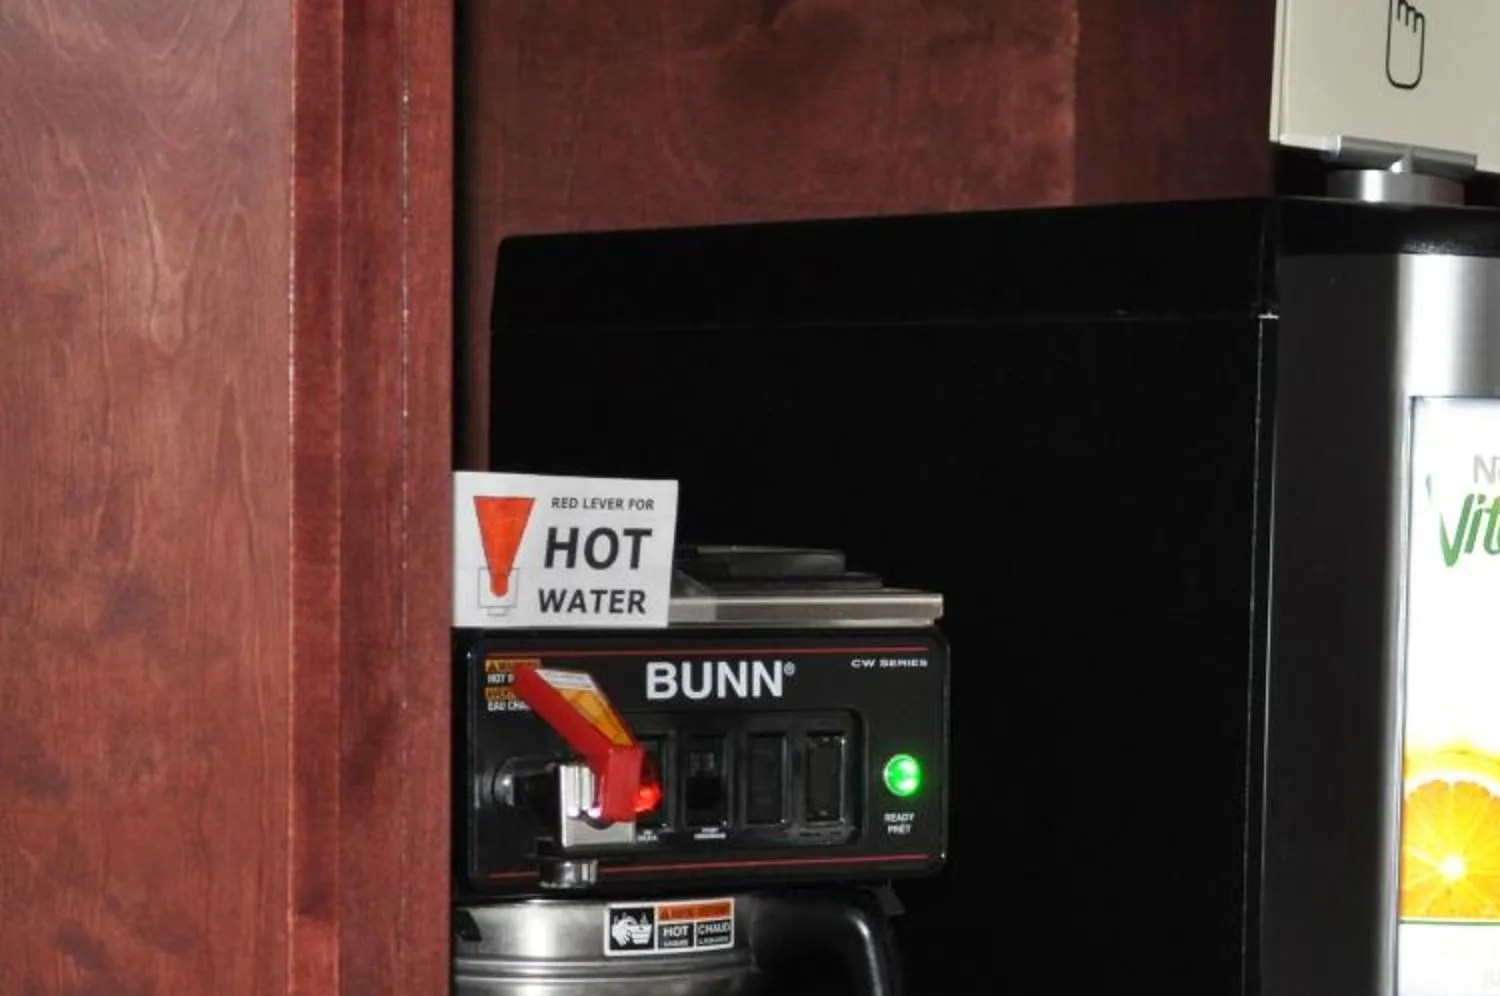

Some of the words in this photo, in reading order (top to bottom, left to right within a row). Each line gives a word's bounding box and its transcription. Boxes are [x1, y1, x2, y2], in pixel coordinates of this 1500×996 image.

[551, 497, 579, 510] RED
[582, 498, 625, 511] LEVER
[628, 498, 654, 511] FOR
[544, 527, 653, 570] HOT
[538, 589, 647, 614] WATER
[851, 659, 876, 668] CW
[880, 658, 928, 668] SERIES
[884, 812, 915, 824] READY
[663, 925, 689, 937] HOT
